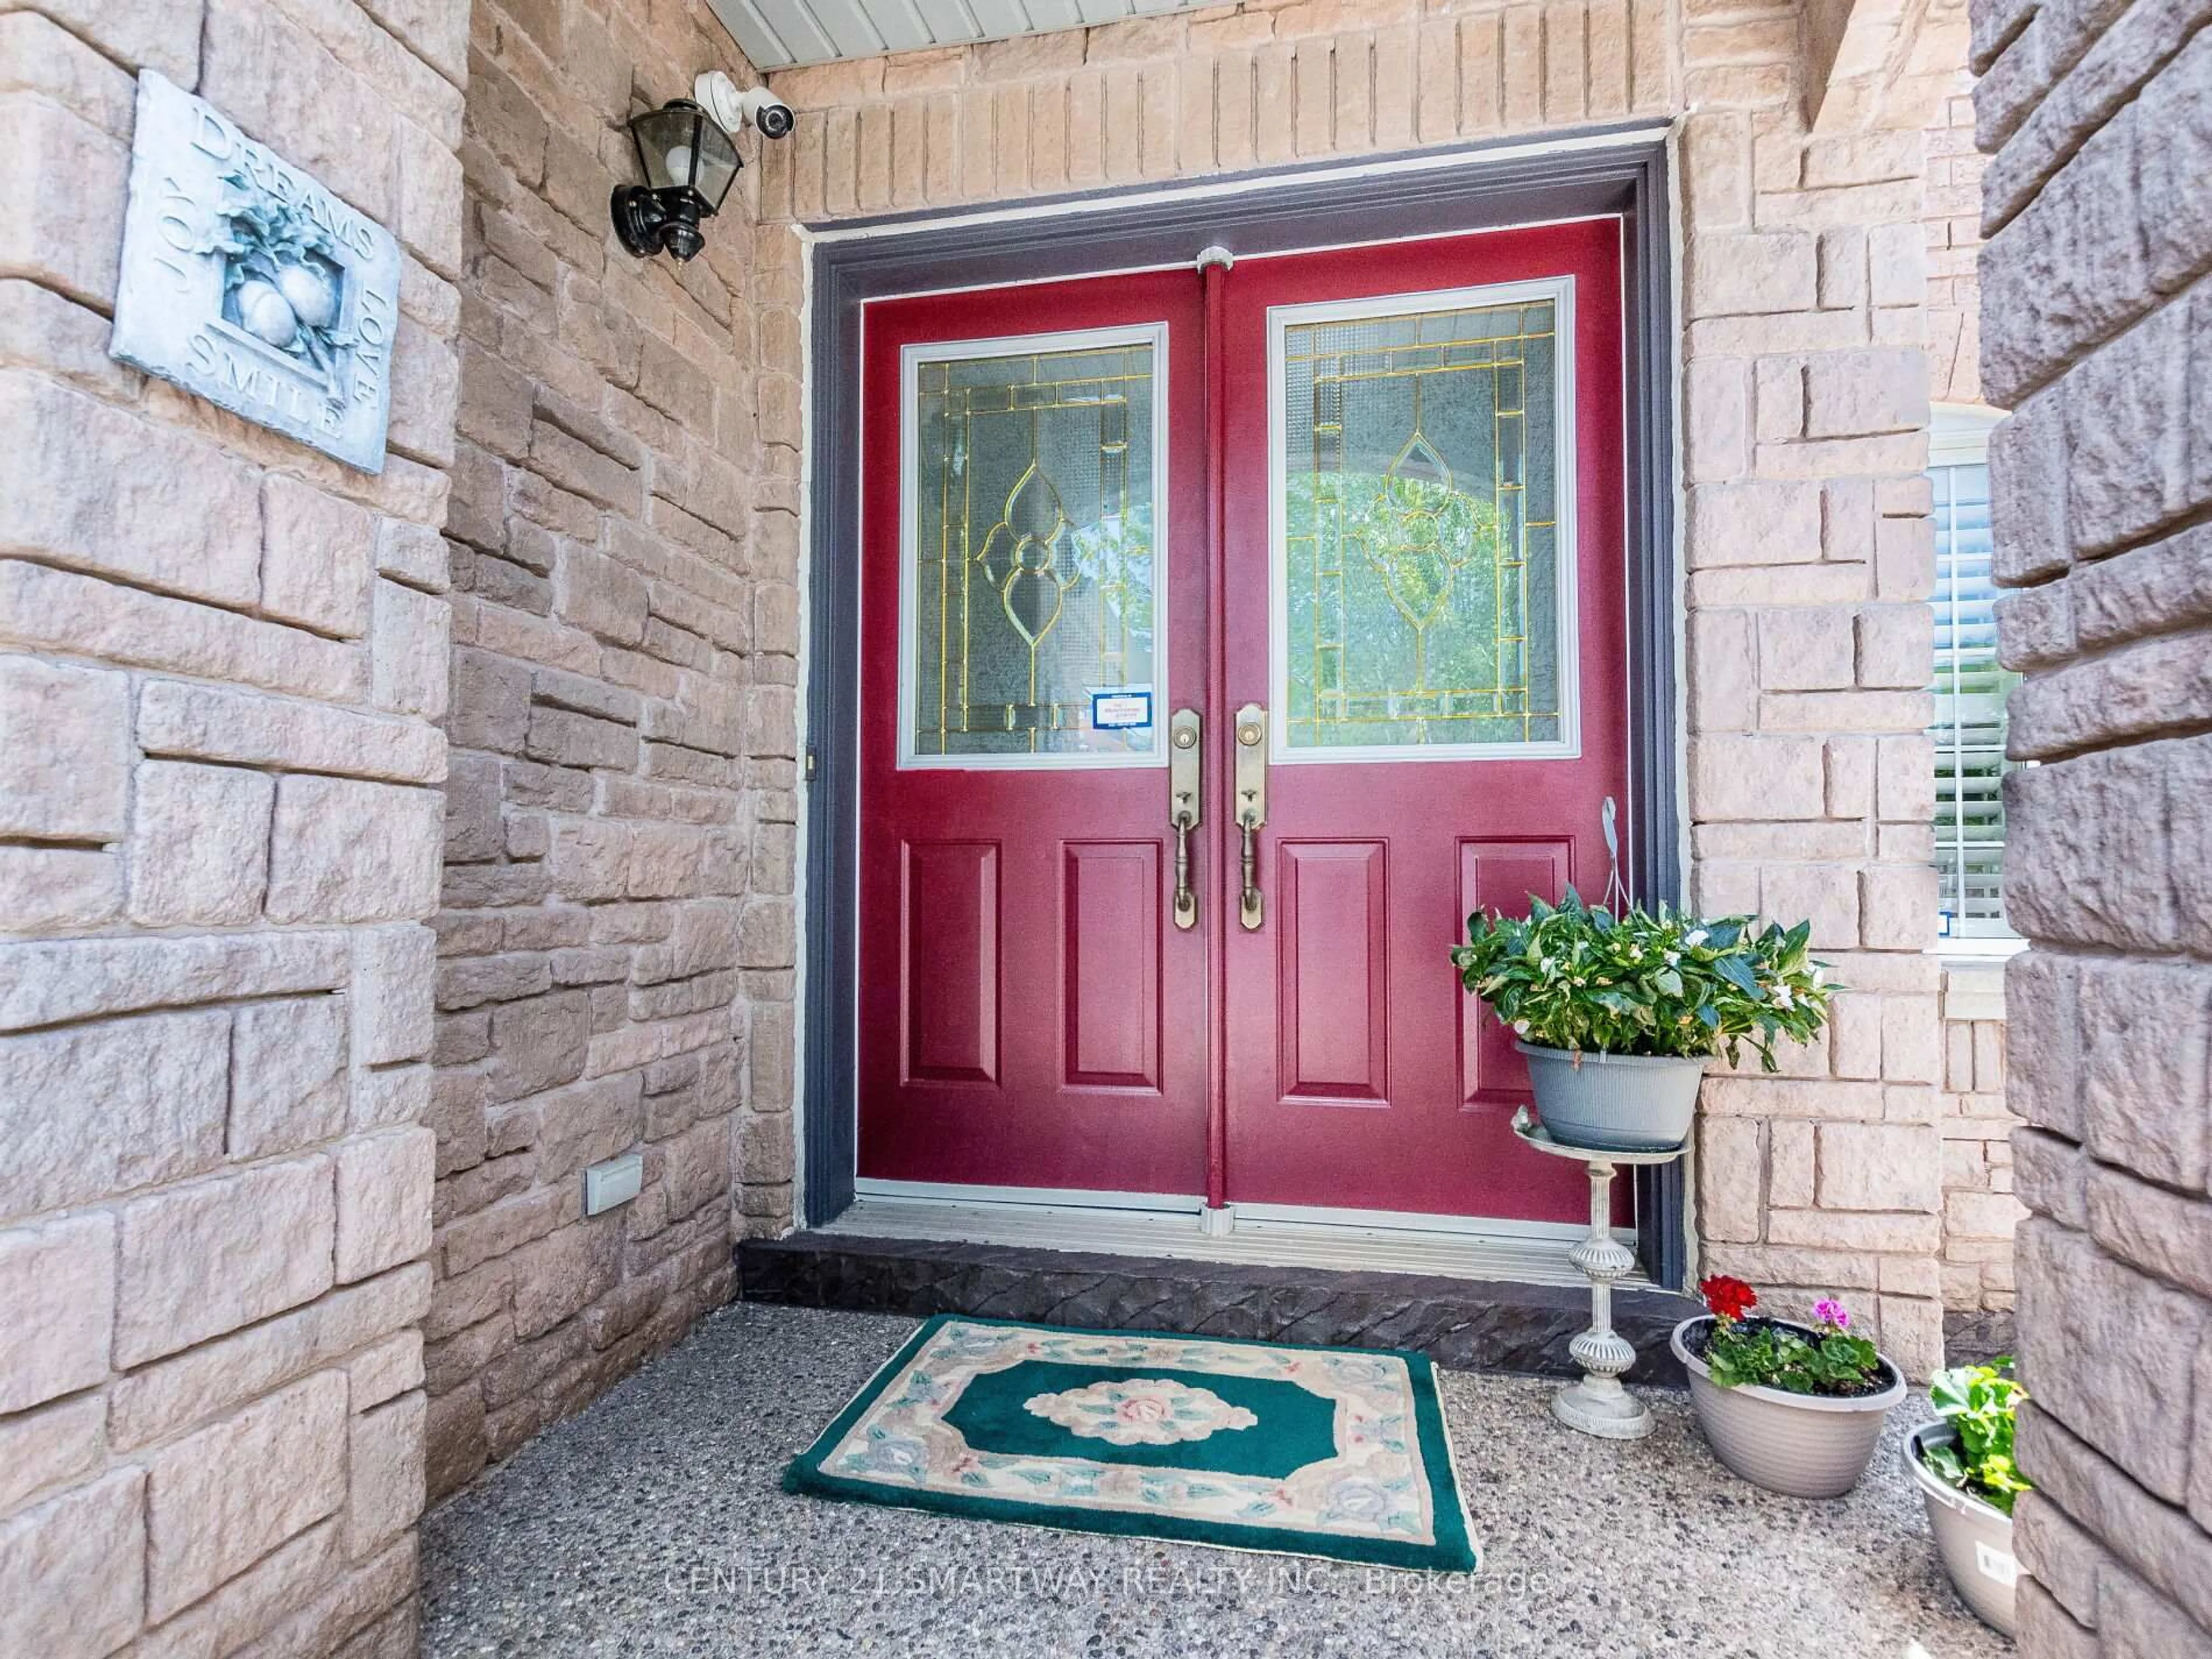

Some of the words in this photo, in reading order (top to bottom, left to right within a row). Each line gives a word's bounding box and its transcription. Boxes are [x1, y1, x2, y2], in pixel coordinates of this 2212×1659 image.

[152, 176, 199, 293] JOY
[190, 105, 376, 261] DREAMS
[184, 333, 346, 439] SMILE
[351, 287, 391, 410] LOVE
